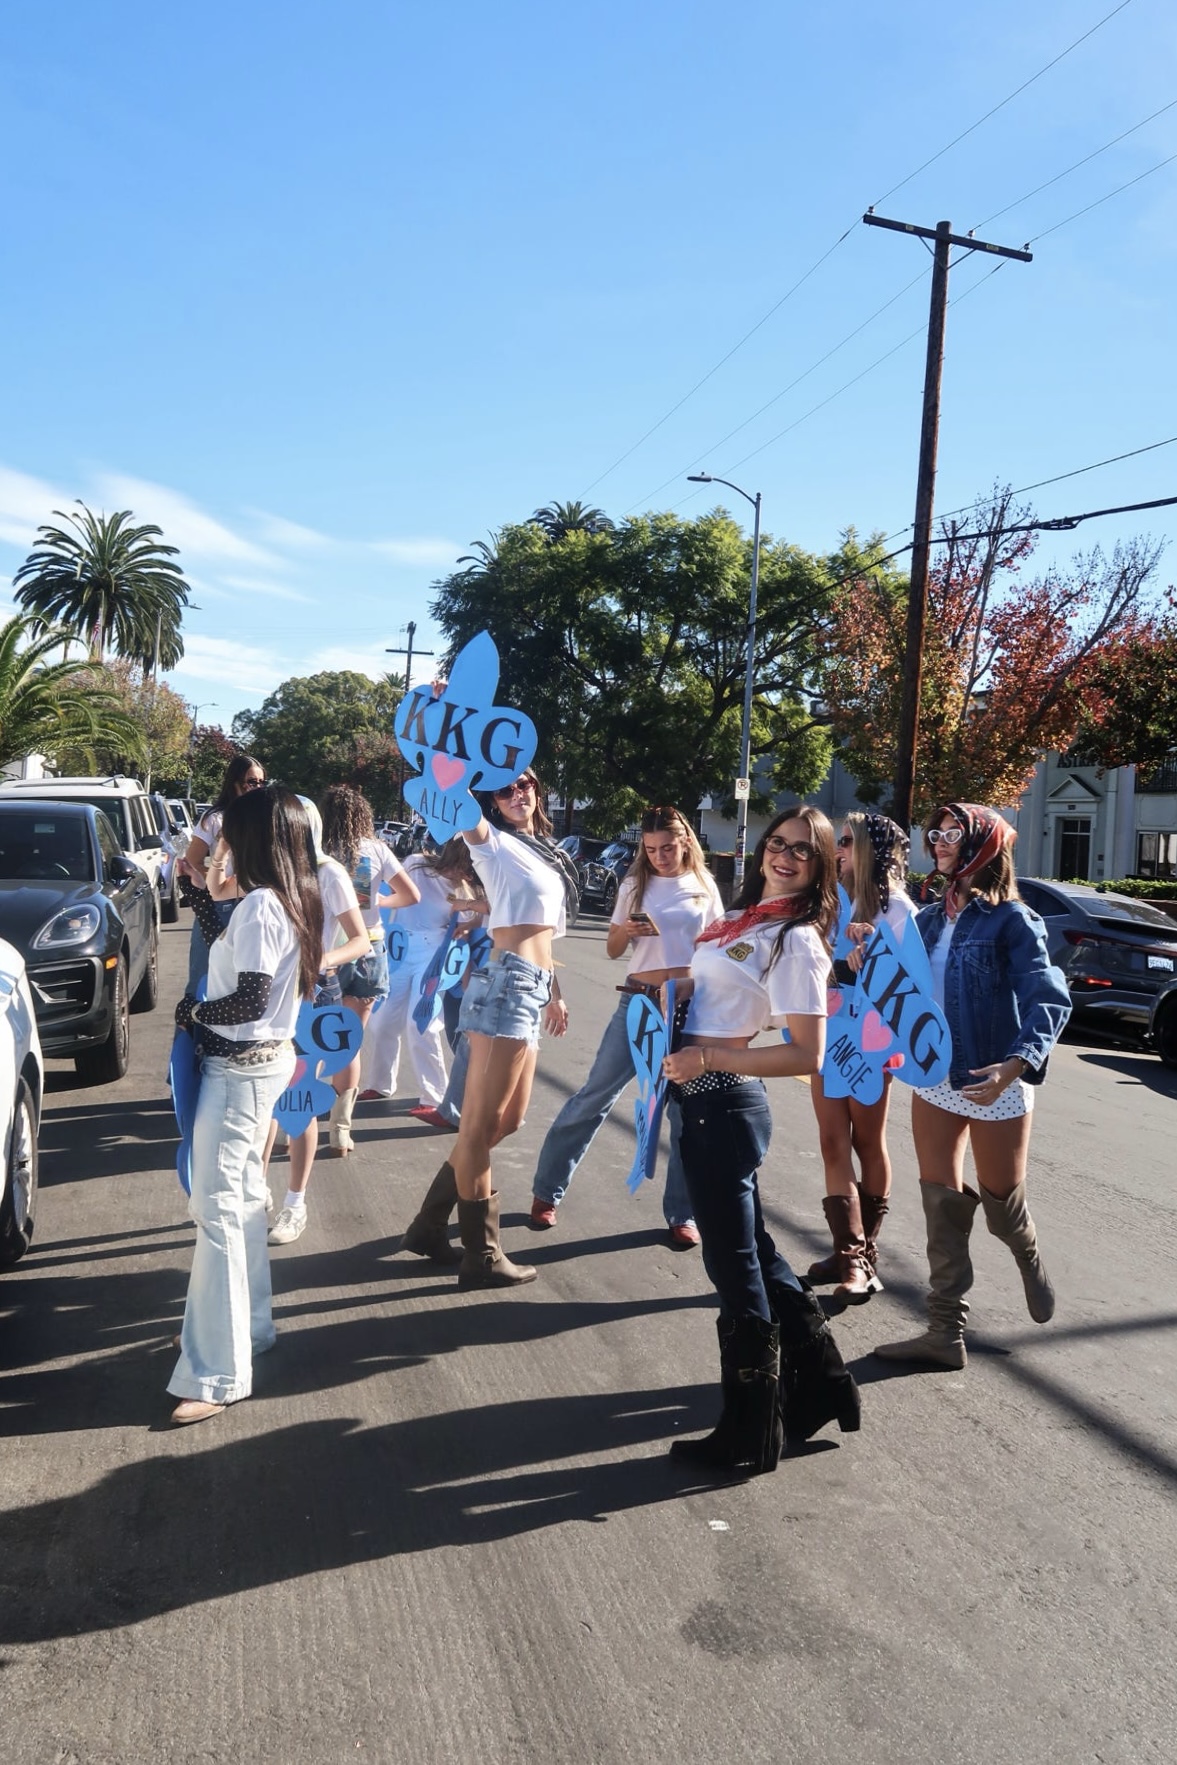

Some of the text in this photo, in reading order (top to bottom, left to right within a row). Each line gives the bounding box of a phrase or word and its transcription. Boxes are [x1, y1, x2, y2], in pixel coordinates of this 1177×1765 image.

[399, 692, 525, 771] KKG
[419, 788, 463, 826] ALLY
[860, 927, 945, 1076] KKG
[827, 1034, 873, 1094] ANGIE
